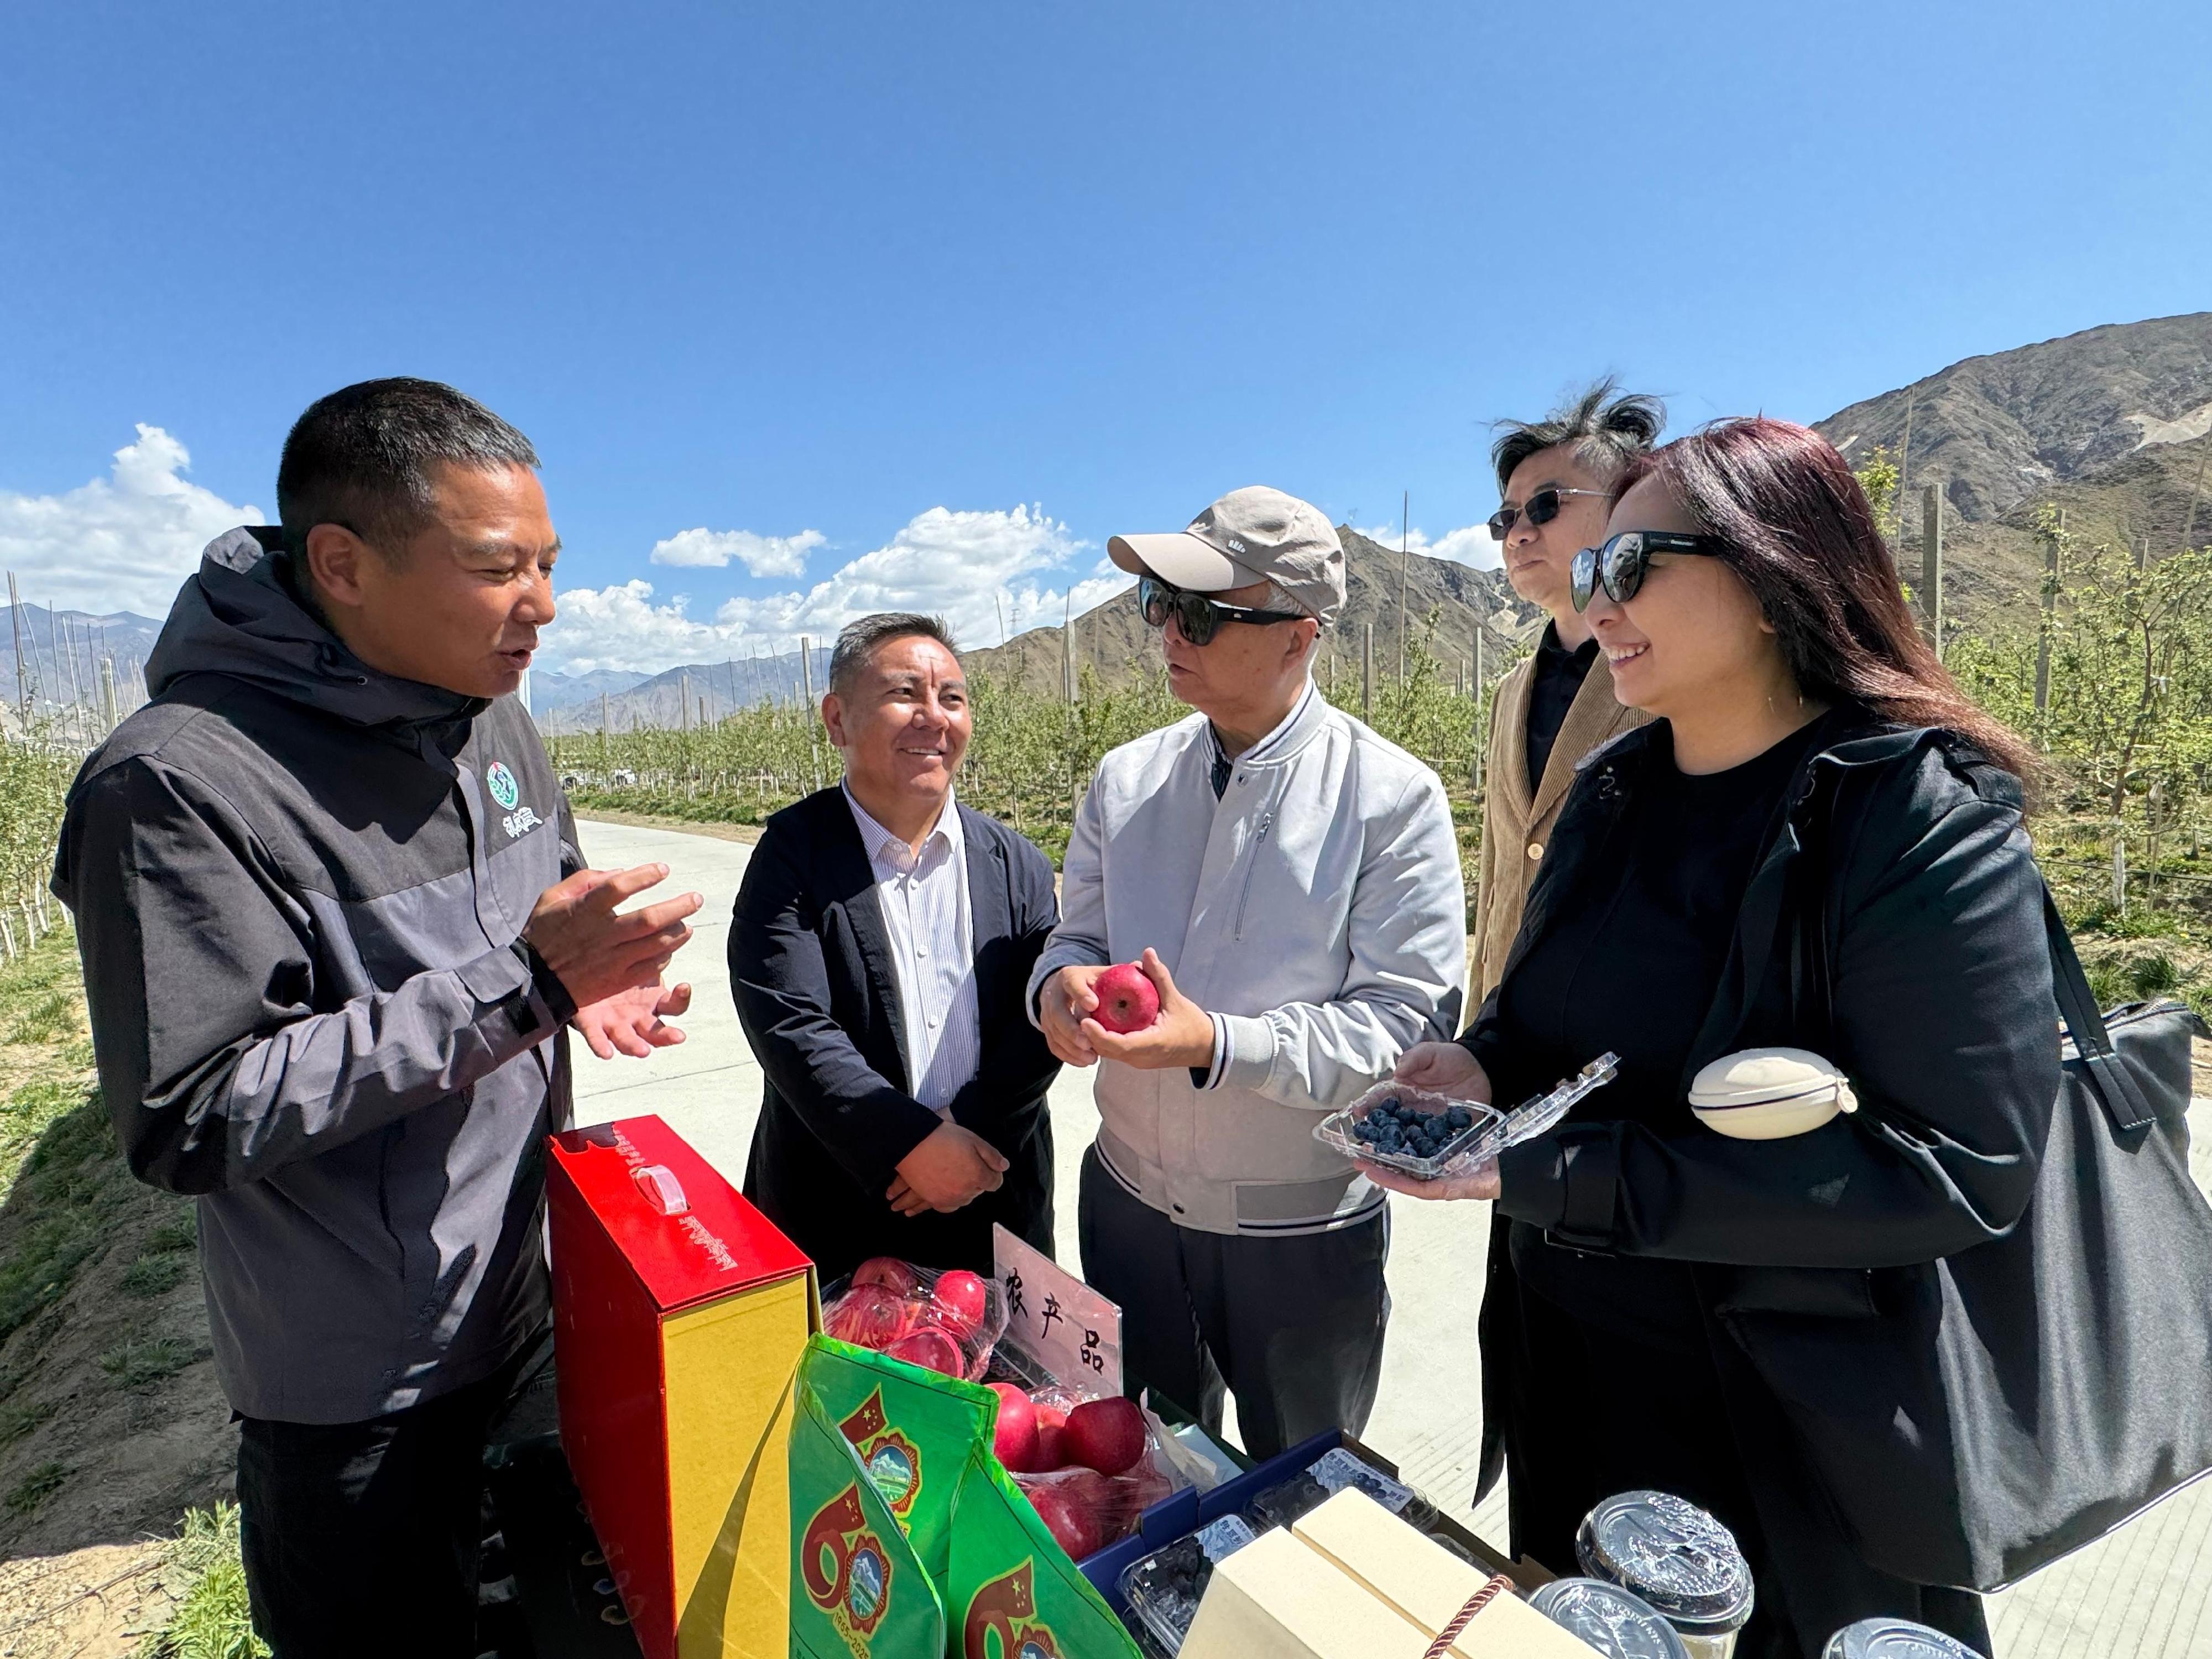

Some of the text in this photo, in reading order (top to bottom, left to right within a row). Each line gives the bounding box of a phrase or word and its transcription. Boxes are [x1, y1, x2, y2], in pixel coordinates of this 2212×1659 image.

[1006, 1267, 1104, 1376] 农产品
[834, 1612, 869, 1659] 1965-2025
